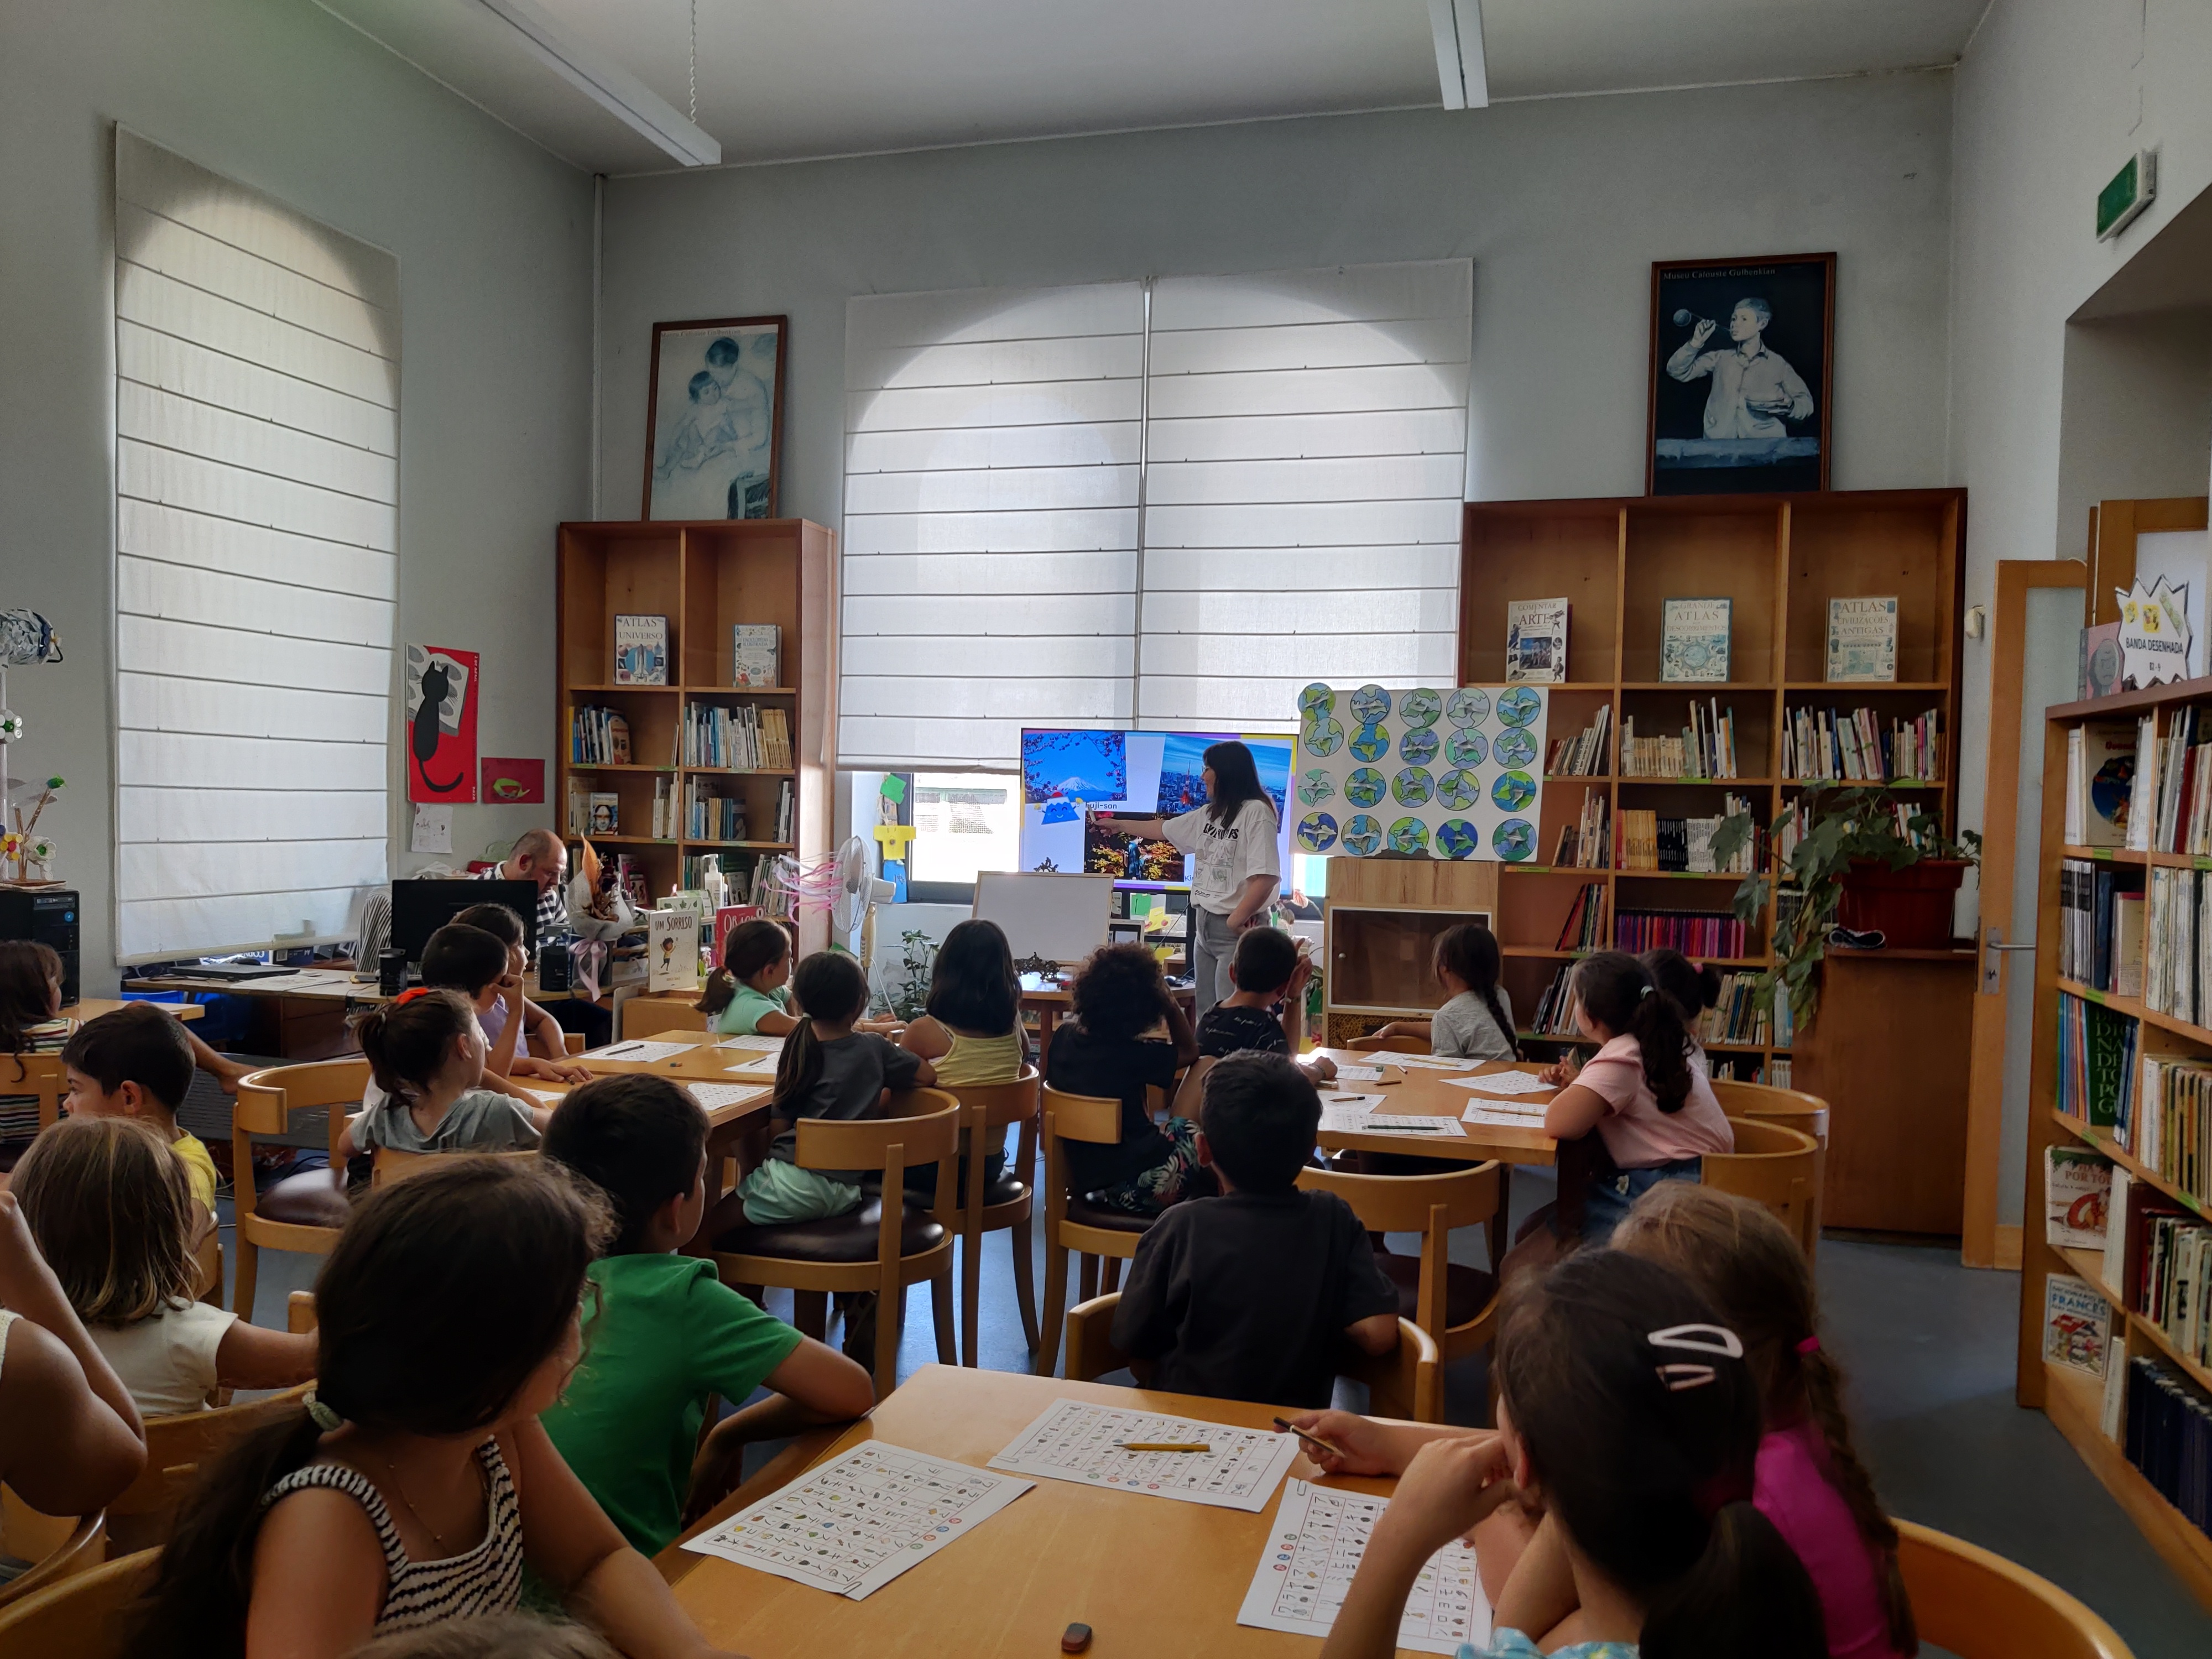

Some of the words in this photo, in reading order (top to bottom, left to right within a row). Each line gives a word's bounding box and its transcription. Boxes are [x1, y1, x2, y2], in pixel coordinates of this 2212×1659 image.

[1663, 272, 1689, 280] Museu
[1692, 270, 1727, 279] Calouste
[1729, 268, 1776, 276] Gulbenkian
[1840, 601, 1886, 613] ATLAS
[1519, 613, 1551, 625] ARTE
[1674, 611, 1719, 620] ATLAS
[623, 618, 657, 627] ATLAS
[619, 632, 662, 640] UNIVERSO
[1841, 627, 1884, 635] ANTIGAS
[2126, 637, 2147, 650] BANDA
[2148, 640, 2184, 654] DESENHADA
[1085, 801, 1117, 810] Fuji-san
[655, 920, 664, 931] UM
[666, 916, 692, 931] SORRISO
